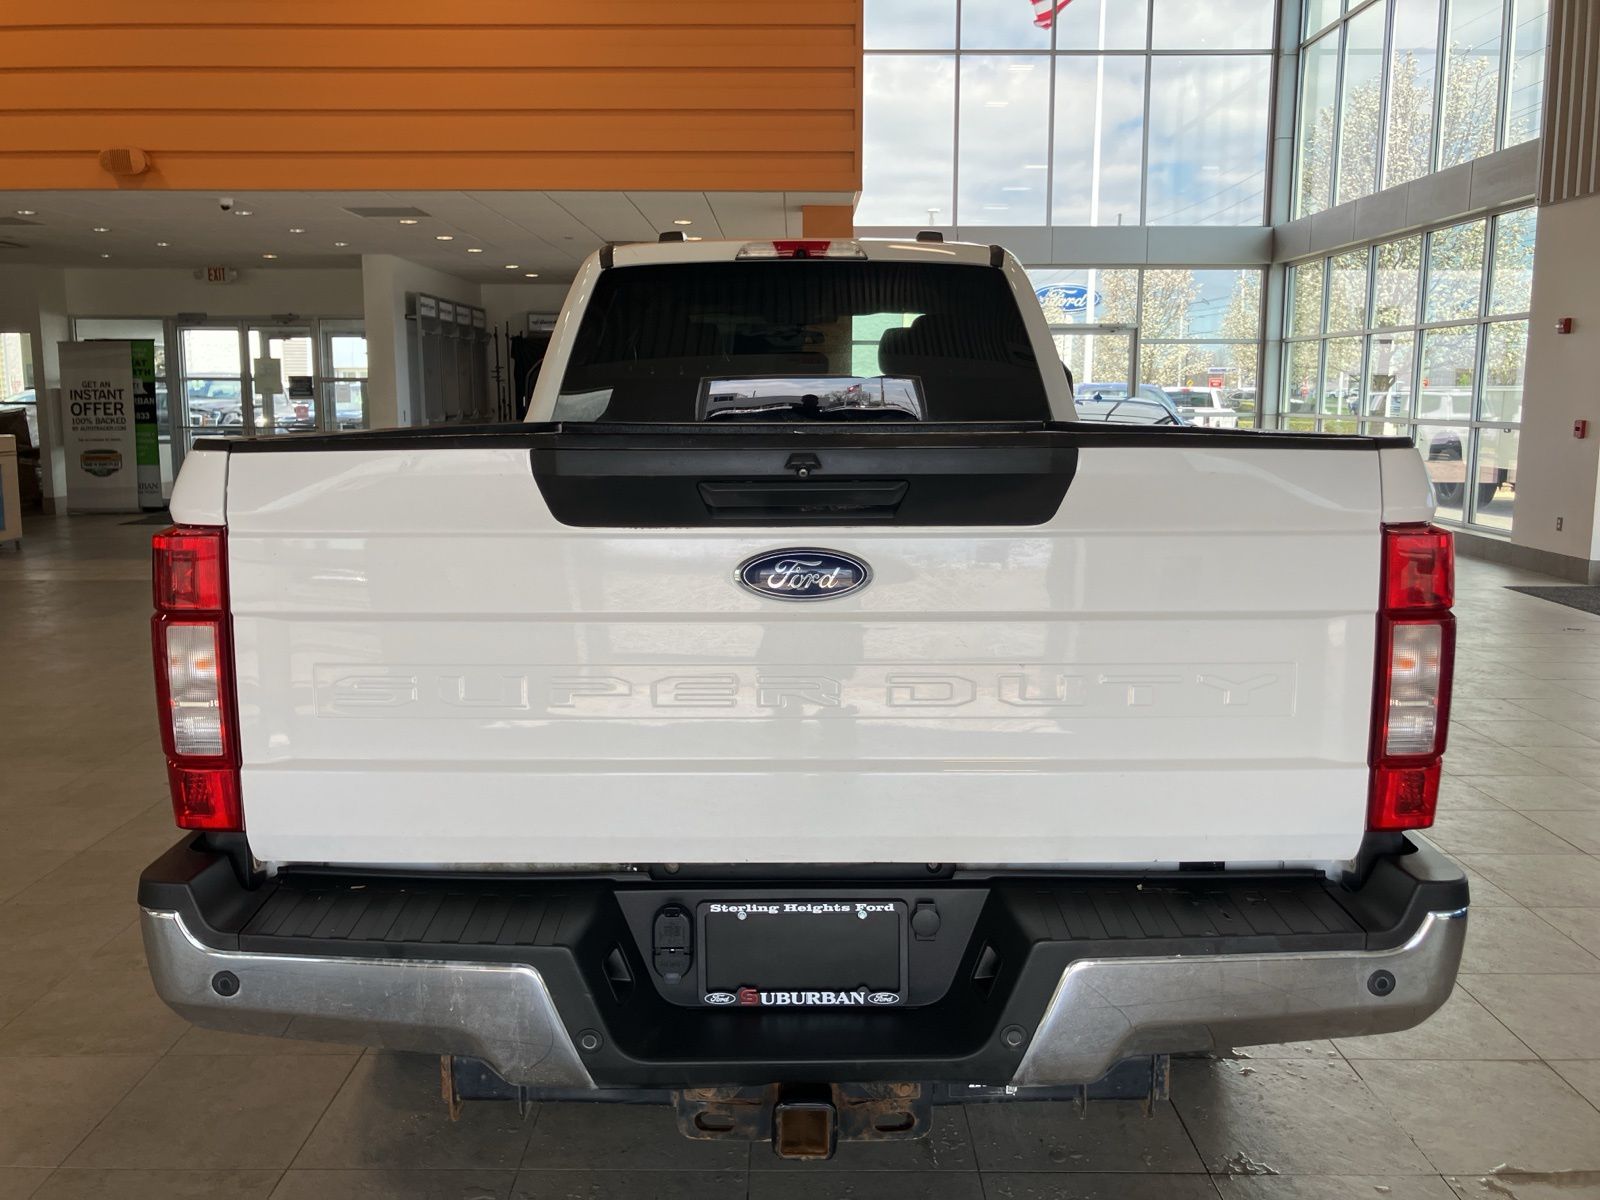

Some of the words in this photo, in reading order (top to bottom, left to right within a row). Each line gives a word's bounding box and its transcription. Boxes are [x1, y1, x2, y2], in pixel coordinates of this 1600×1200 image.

[207, 266, 225, 282] EXIT
[1039, 288, 1089, 307] Ford
[81, 381, 97, 389] GET
[69, 389, 125, 401] INSTANT
[70, 402, 125, 417] OFFER
[71, 417, 93, 425] 100%
[95, 417, 127, 425] BACKED
[767, 559, 841, 590] Ford
[331, 673, 842, 709] SUPER
[886, 672, 1280, 708] DUTY
[710, 903, 780, 914] Sterling
[783, 903, 851, 914] Heights
[854, 903, 895, 913] Ford
[739, 988, 866, 1006] SUBURBAN
